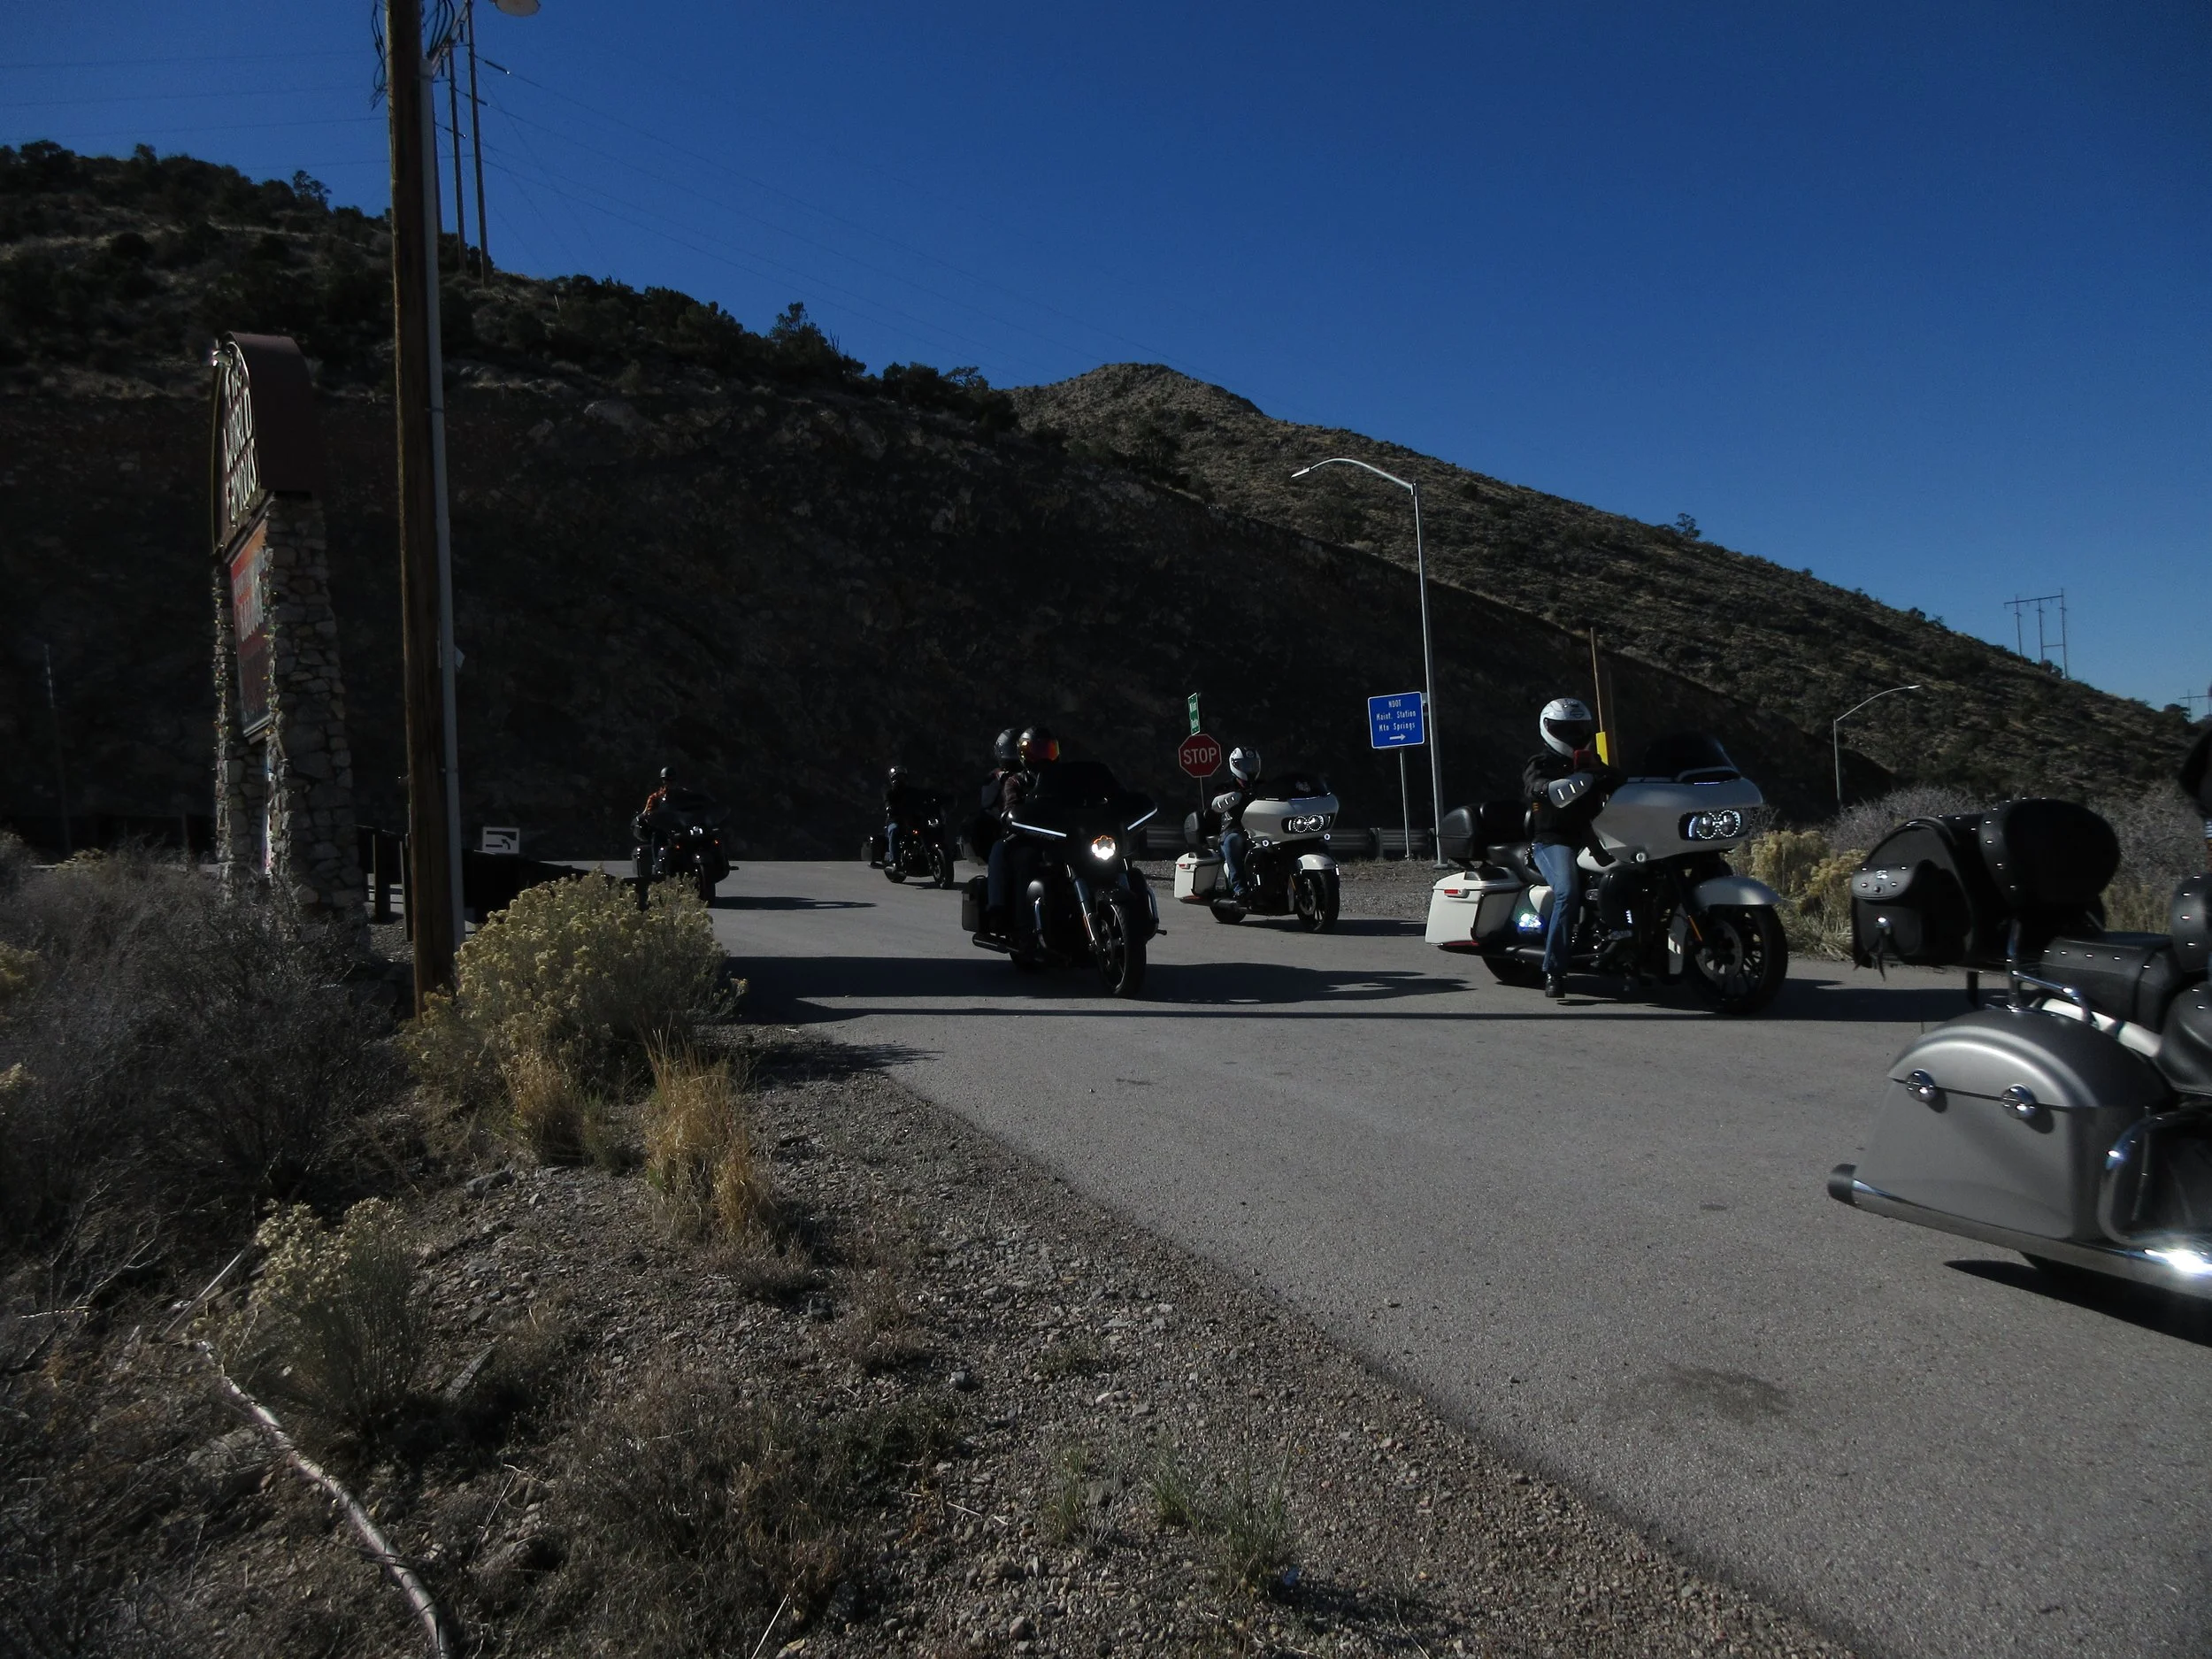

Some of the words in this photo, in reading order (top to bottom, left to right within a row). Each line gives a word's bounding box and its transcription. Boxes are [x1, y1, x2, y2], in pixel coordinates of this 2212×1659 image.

[223, 386, 253, 473] WORLD
[226, 438, 257, 522] FAMOUS
[1388, 699, 1402, 708] NDOT
[1393, 722, 1416, 732] Springs
[1183, 747, 1217, 765] STOP
